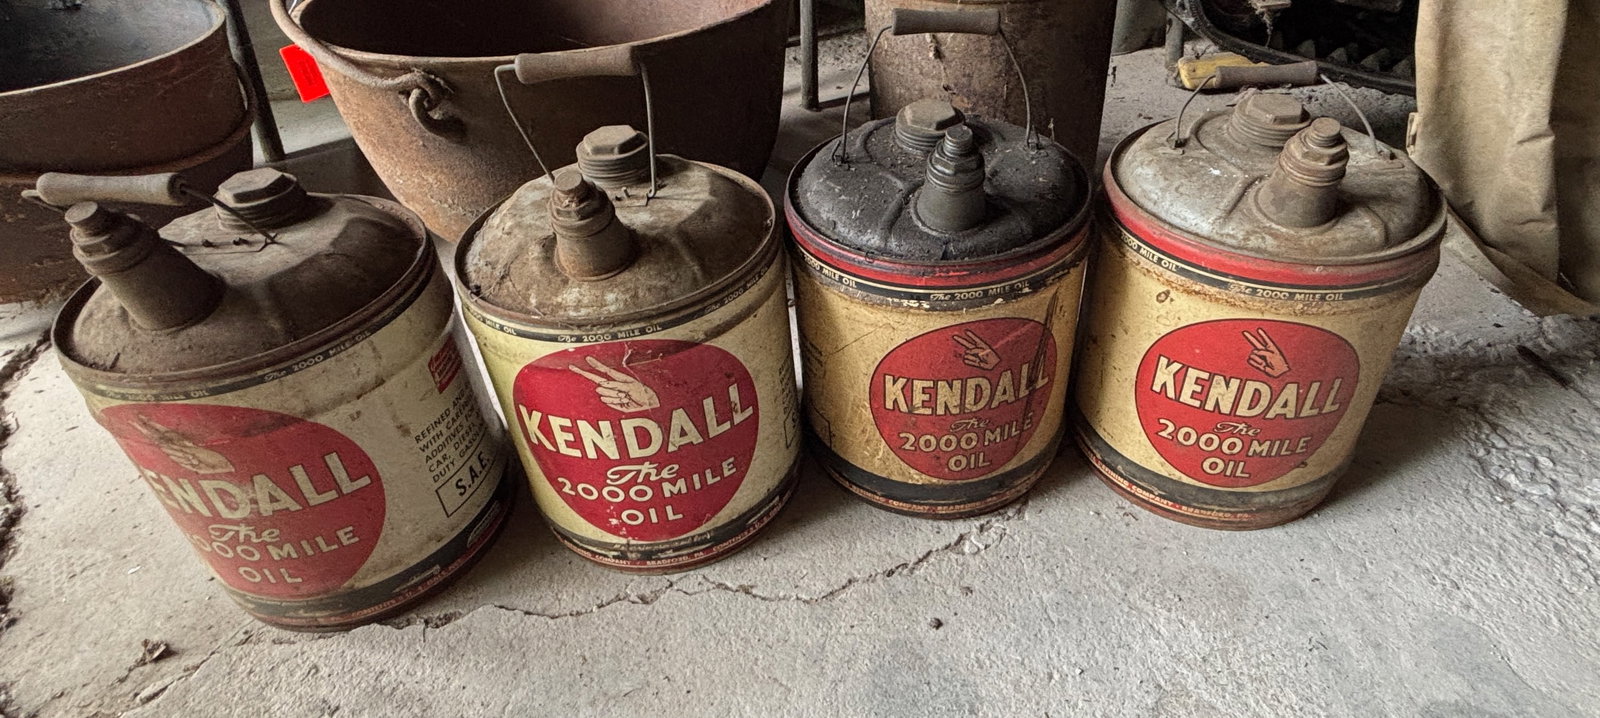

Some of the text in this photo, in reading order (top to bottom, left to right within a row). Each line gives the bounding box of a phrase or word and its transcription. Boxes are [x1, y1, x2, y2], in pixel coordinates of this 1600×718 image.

[1140, 248, 1158, 263] MILE
[1161, 260, 1177, 272] OIL
[822, 268, 840, 281] MILE
[842, 278, 857, 289] OIL
[929, 281, 1030, 301] The 2000 MILE OIL
[1255, 288, 1289, 300] 2000
[1293, 292, 1321, 301] MILE
[1325, 292, 1344, 301] OIL
[503, 325, 517, 336] OIL
[582, 334, 611, 343] 2000
[617, 328, 641, 339] MILE
[645, 324, 663, 334] OIL
[292, 354, 324, 372] 2000
[328, 342, 350, 357] MILE
[354, 330, 371, 342] OIL
[190, 390, 209, 399] OIL
[884, 361, 1049, 416] KENDALL
[1150, 356, 1344, 419] KENDALL
[414, 407, 451, 444] REFINED
[519, 383, 753, 460] KENDALL
[899, 412, 1033, 452] 2000 MILE
[950, 417, 990, 433] The
[1213, 421, 1261, 437] The
[419, 430, 444, 453] WITH
[424, 423, 464, 464] ADDITIVES
[1156, 418, 1312, 457] 2000 MILE
[428, 453, 451, 474] CAR,
[432, 459, 455, 483] DUTY
[606, 461, 680, 486] The
[947, 452, 992, 472] OIL
[1201, 457, 1251, 478] OIL
[140, 451, 372, 520] ENDALL
[455, 451, 490, 497] S.A.E.
[557, 456, 737, 502] 2000 MILE
[1131, 485, 1173, 507] COMPANY
[621, 504, 684, 526] OIL
[208, 523, 281, 543] The
[267, 525, 360, 561] MILE
[238, 566, 303, 584] OIL
